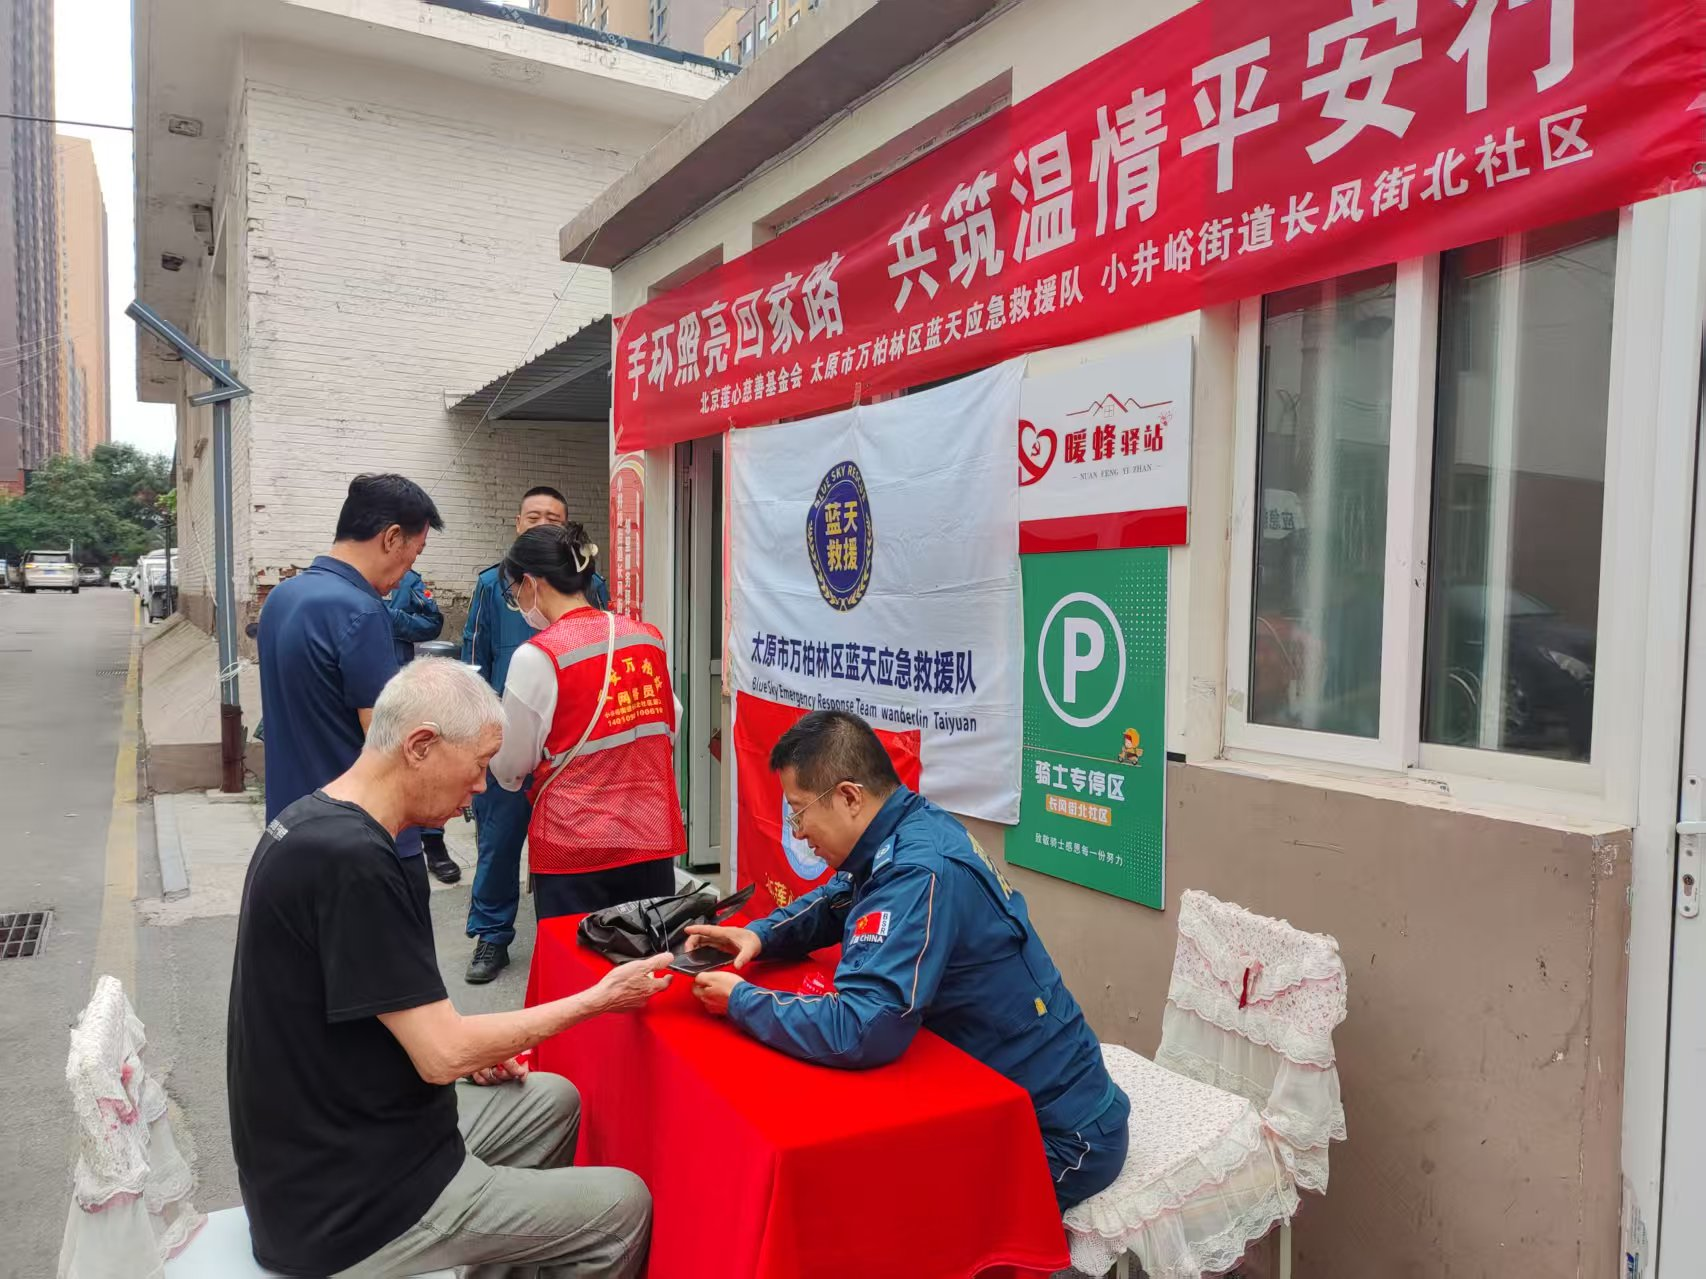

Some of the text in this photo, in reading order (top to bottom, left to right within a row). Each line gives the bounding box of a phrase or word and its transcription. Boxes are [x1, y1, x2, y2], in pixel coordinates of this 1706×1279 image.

[627, 0, 1575, 402] 手环照亮回家路 共筑温情平安行
[700, 104, 1594, 414] 北京莲心慈善基金会 太原市万柏林区蓝天应急救援队 小井峪街道长风街北社区
[1064, 423, 1163, 464] 暖蜂驿站
[814, 465, 866, 509] BLUE SKY RESCUE
[1132, 464, 1152, 473] ZHAN
[825, 501, 858, 536] 蓝天
[827, 537, 858, 572] 救援
[751, 631, 977, 695] 太原市万柏林区蓝天应急救援队
[1064, 617, 1105, 704] P
[779, 684, 816, 710] Emergency
[817, 693, 854, 712] Response
[856, 698, 877, 718] Team
[934, 711, 977, 736] Taiyuan
[1035, 760, 1125, 801] 骑士专停区
[1035, 832, 1123, 866] 致敬骑士感恩每一份努力
[860, 934, 883, 943] CHINA
